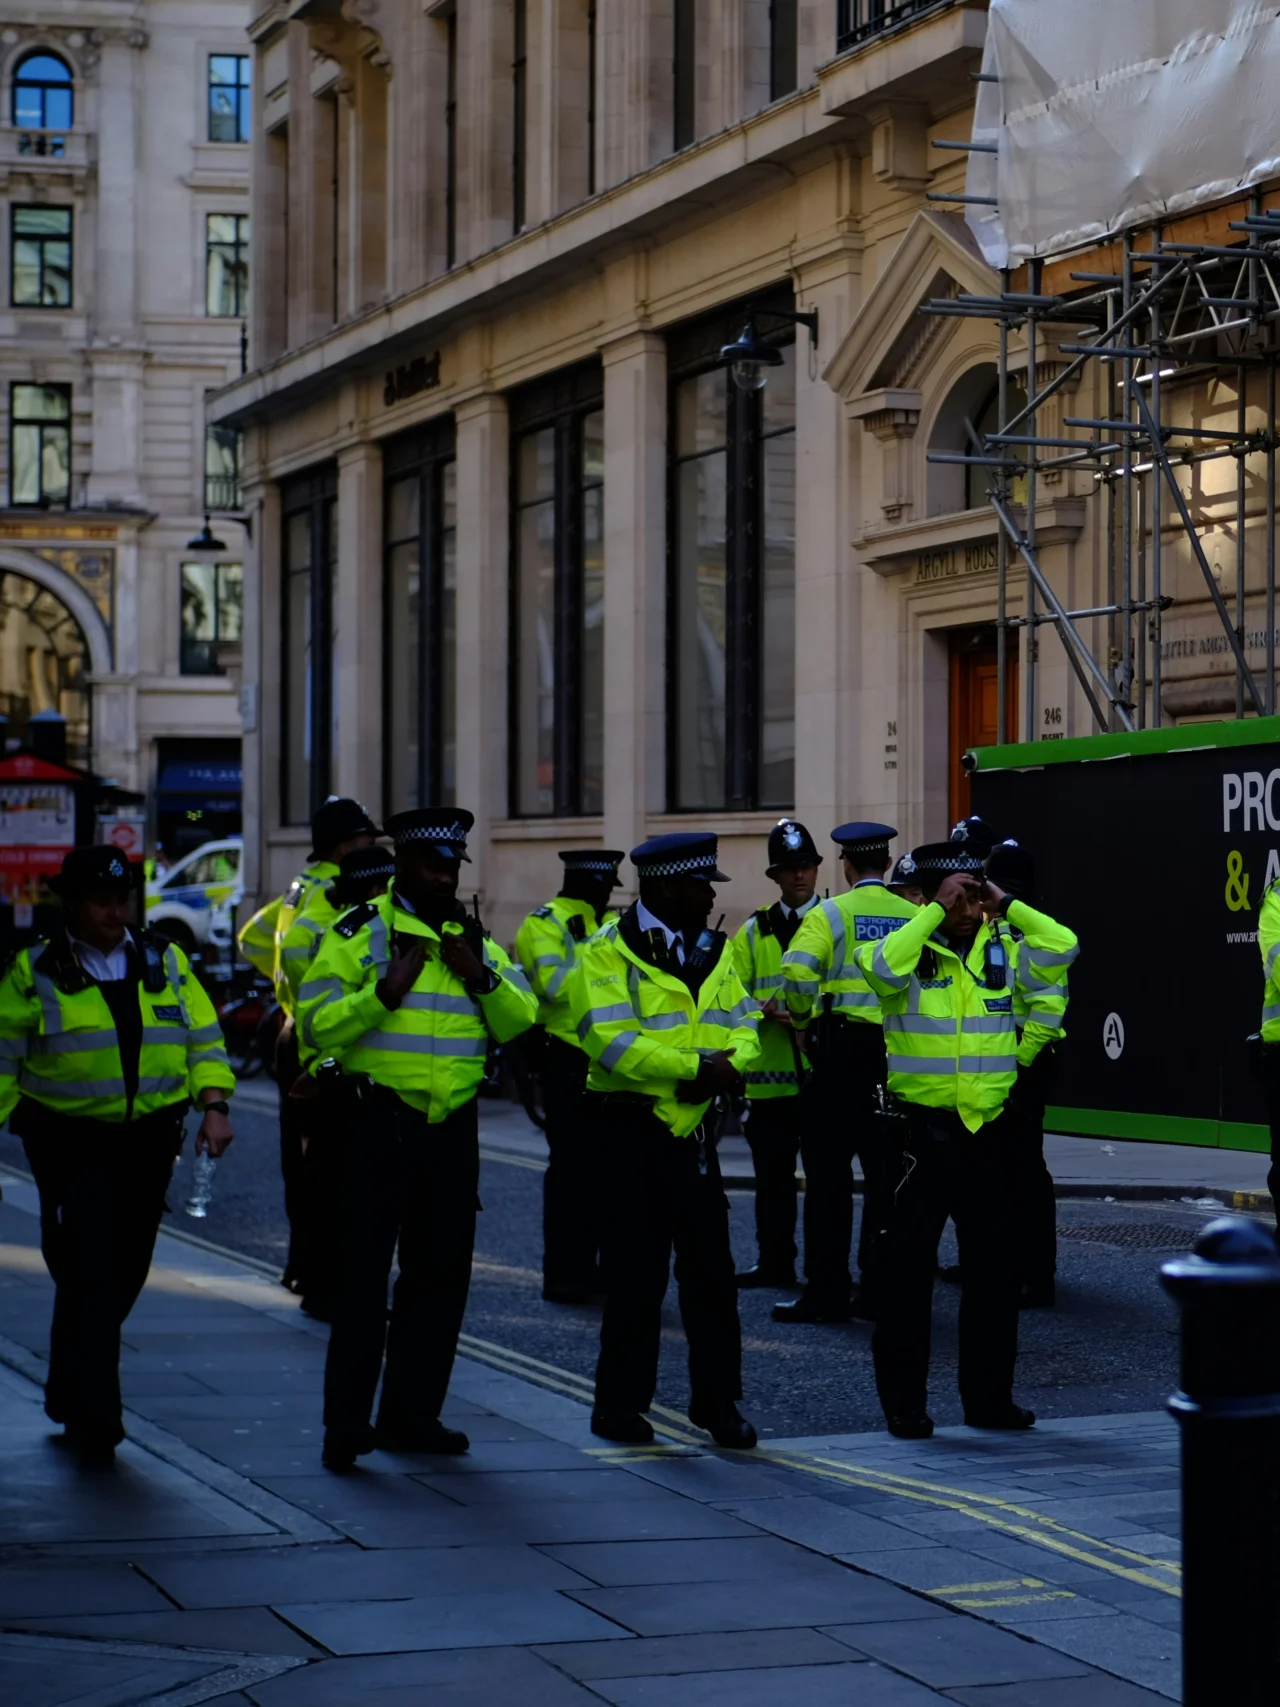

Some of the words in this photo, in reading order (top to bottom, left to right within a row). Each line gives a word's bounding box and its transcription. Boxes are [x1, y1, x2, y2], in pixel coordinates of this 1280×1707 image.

[917, 548, 959, 581] ARGYLL
[965, 540, 1008, 572] HOUS
[1199, 633, 1236, 655] ARGY
[1044, 707, 1062, 725] 246
[887, 720, 897, 737] 24
[1225, 850, 1252, 912] &
[855, 917, 908, 926] METROPOLIT
[591, 974, 618, 988] POLICE
